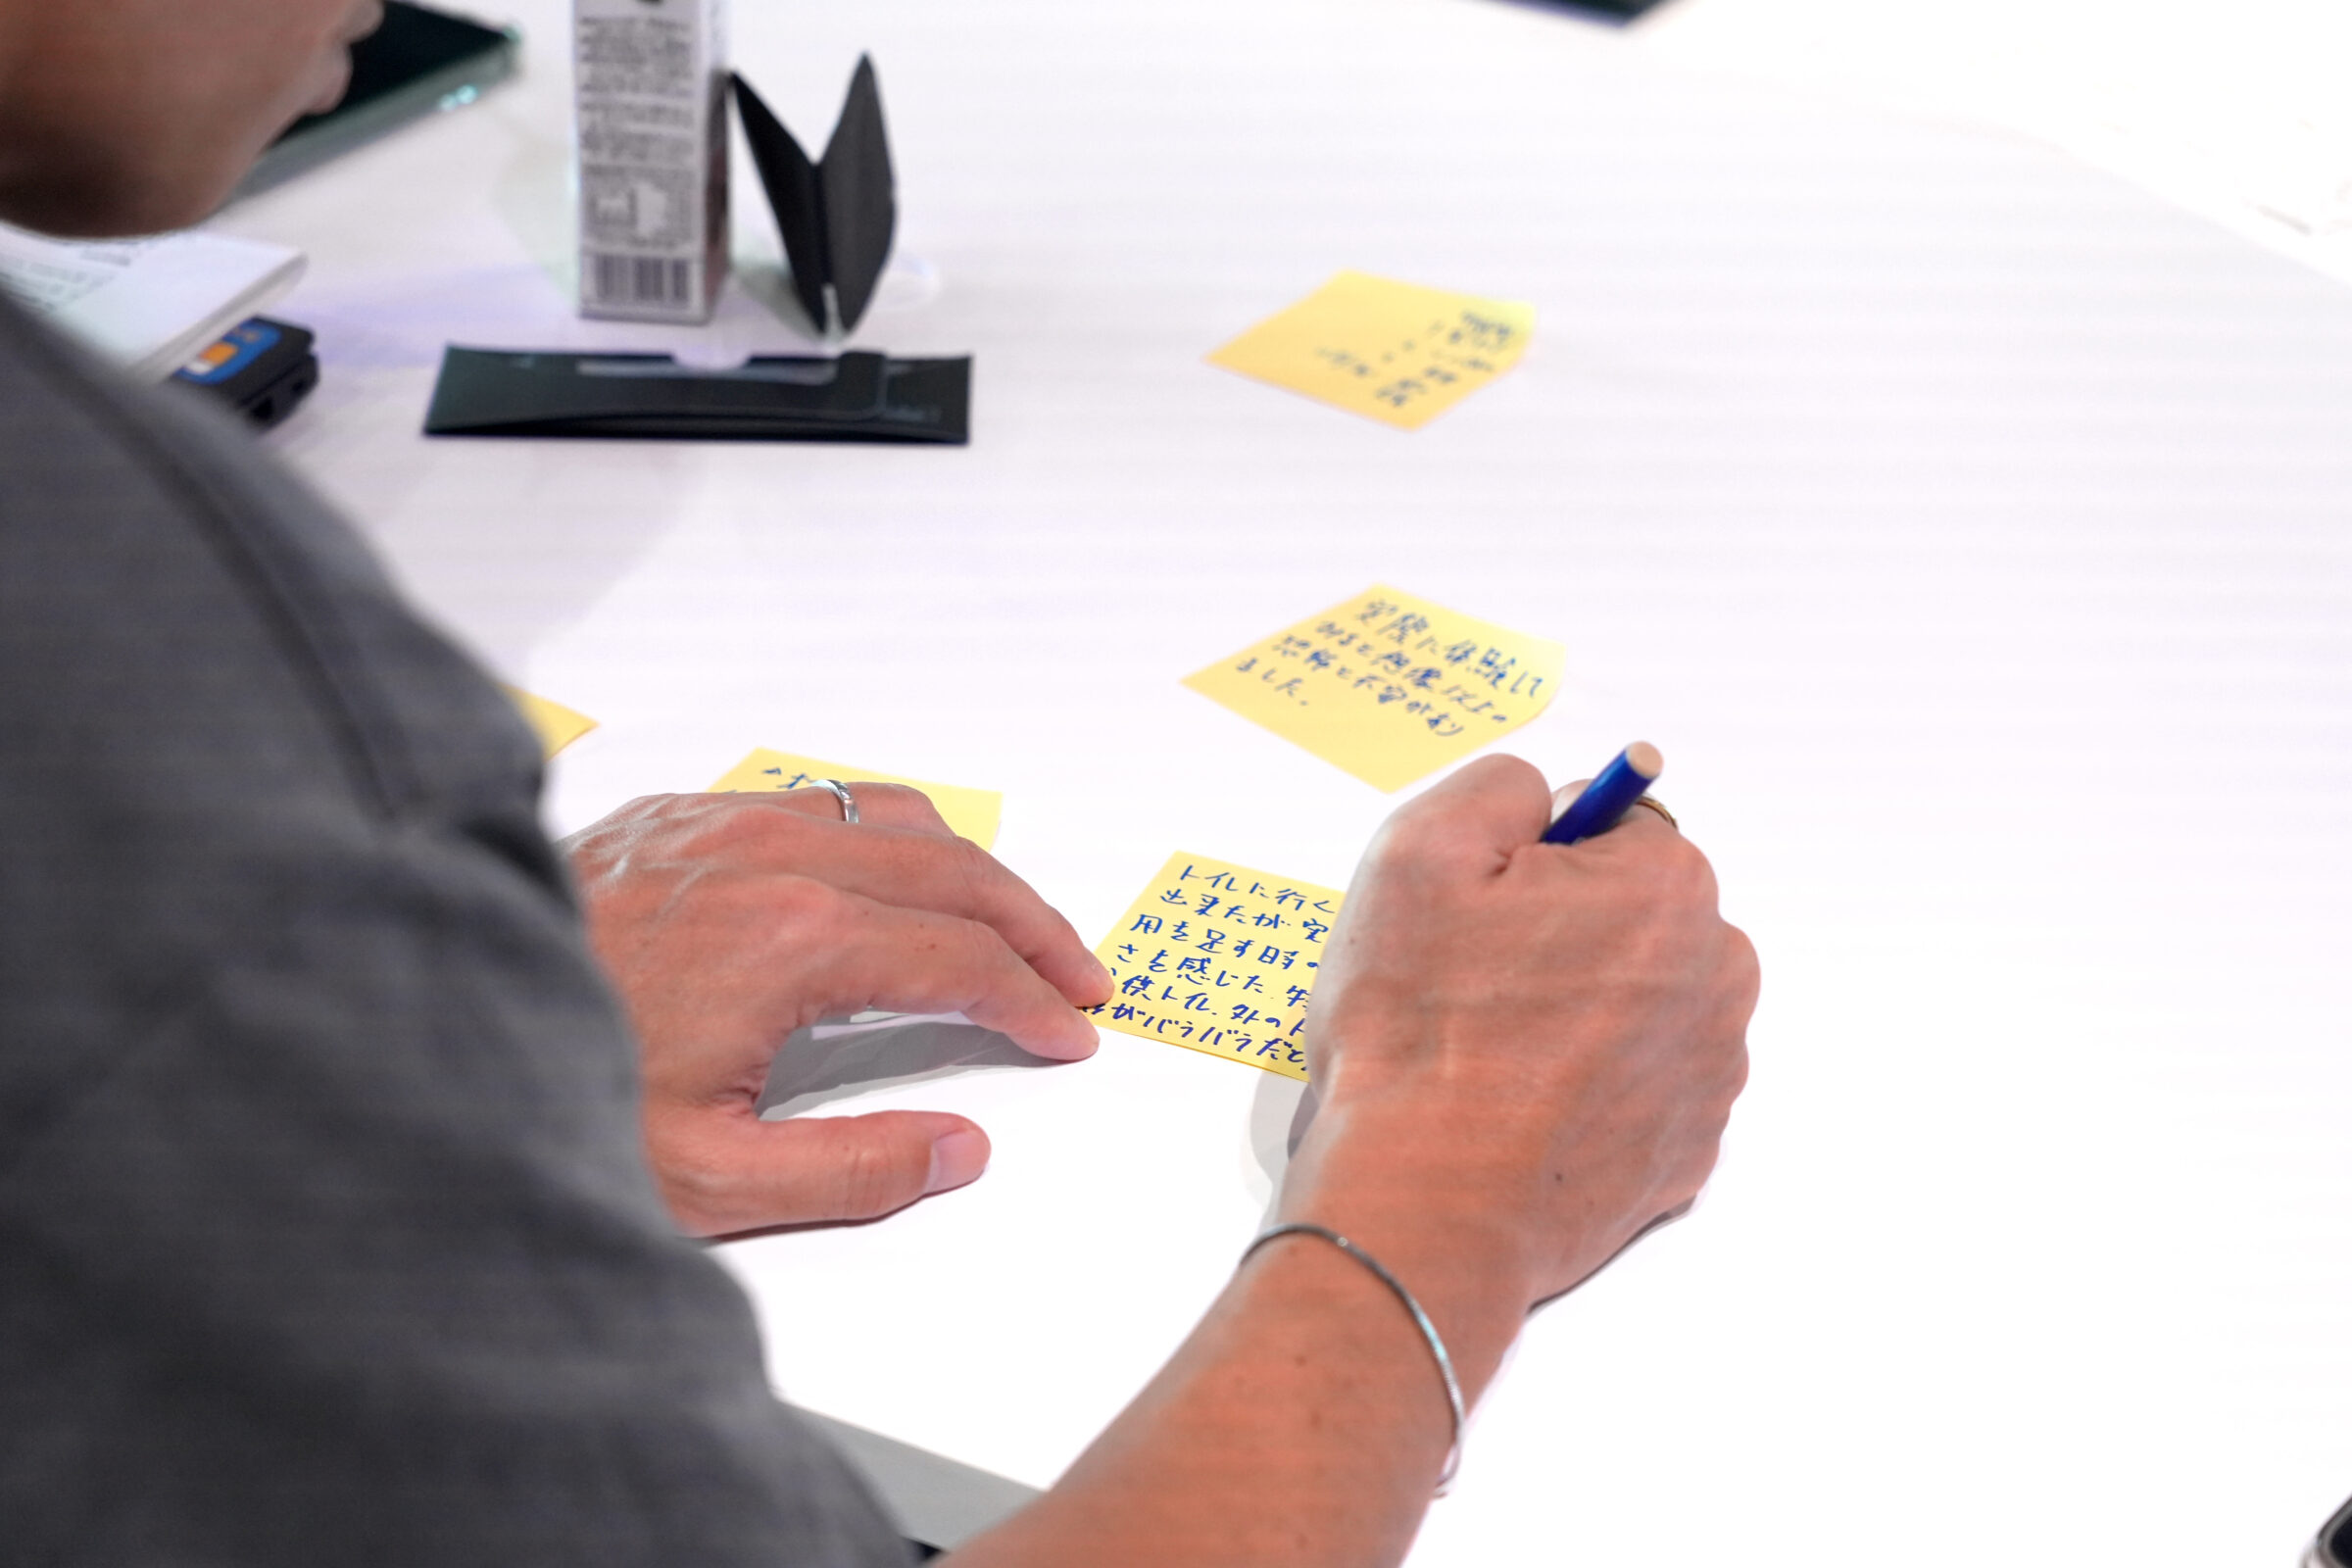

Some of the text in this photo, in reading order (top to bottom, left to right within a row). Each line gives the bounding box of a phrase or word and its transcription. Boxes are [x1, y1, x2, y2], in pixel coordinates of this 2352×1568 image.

[1180, 864, 1335, 913] トイレに行く
[1130, 914, 1319, 970] 用を足す時の
